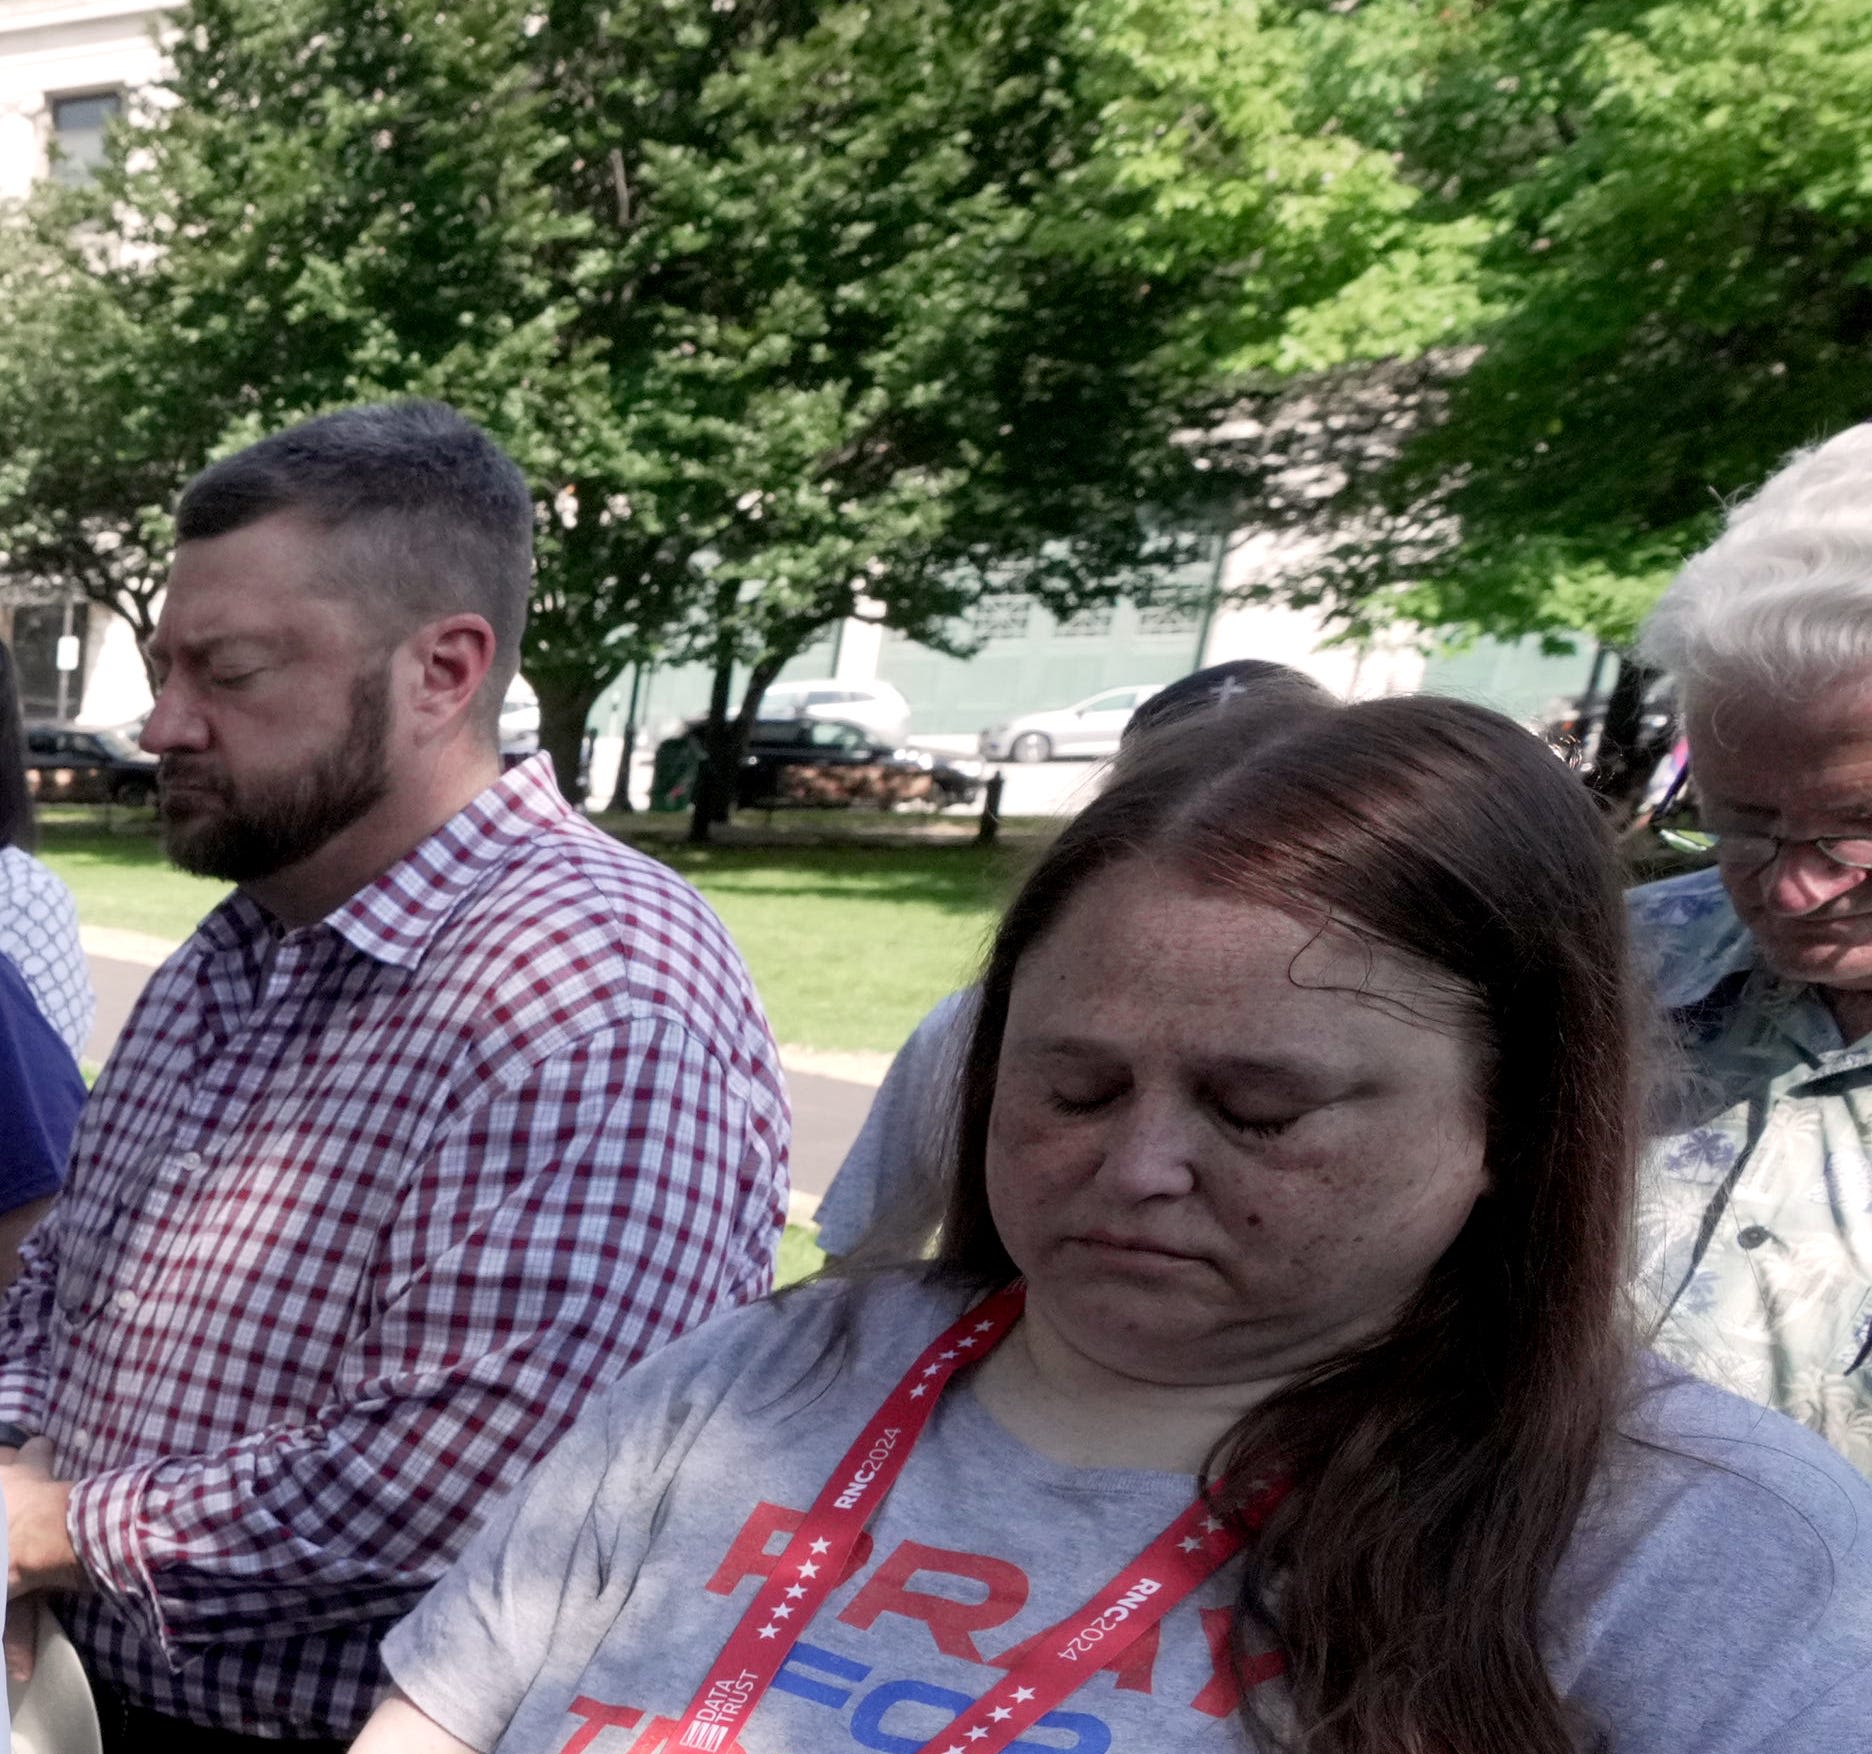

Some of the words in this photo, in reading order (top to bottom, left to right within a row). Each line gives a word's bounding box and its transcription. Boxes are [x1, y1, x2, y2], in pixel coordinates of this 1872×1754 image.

[833, 1426, 902, 1511] RNC2024
[1057, 1577, 1162, 1663] RNC2024
[695, 1677, 735, 1724] DATA
[713, 1668, 760, 1726] TRUST
